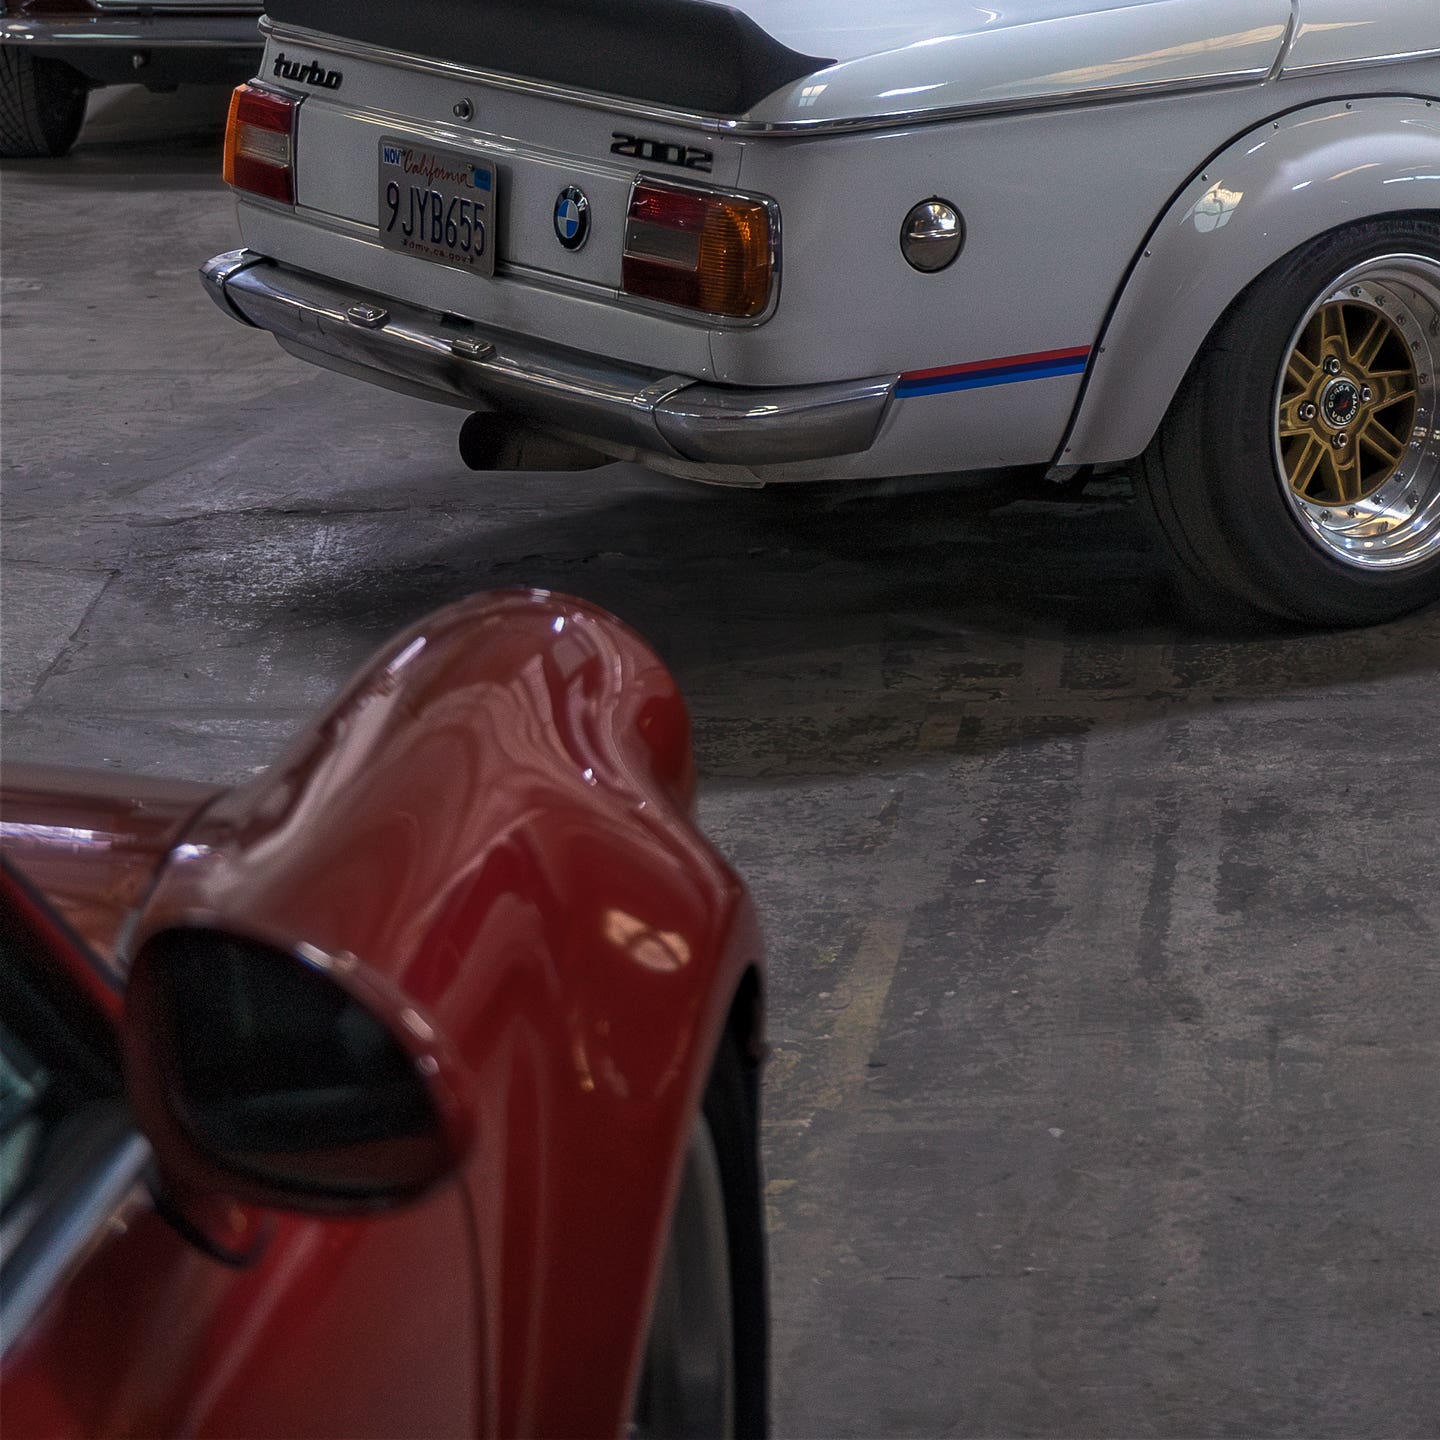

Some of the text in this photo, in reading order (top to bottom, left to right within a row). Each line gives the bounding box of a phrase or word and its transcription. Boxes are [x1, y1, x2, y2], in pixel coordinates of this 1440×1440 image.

[273, 52, 344, 91] turbo
[384, 148, 401, 165] NOV
[403, 149, 475, 189] California
[610, 131, 714, 174] 2002
[386, 181, 486, 257] 9JYB655
